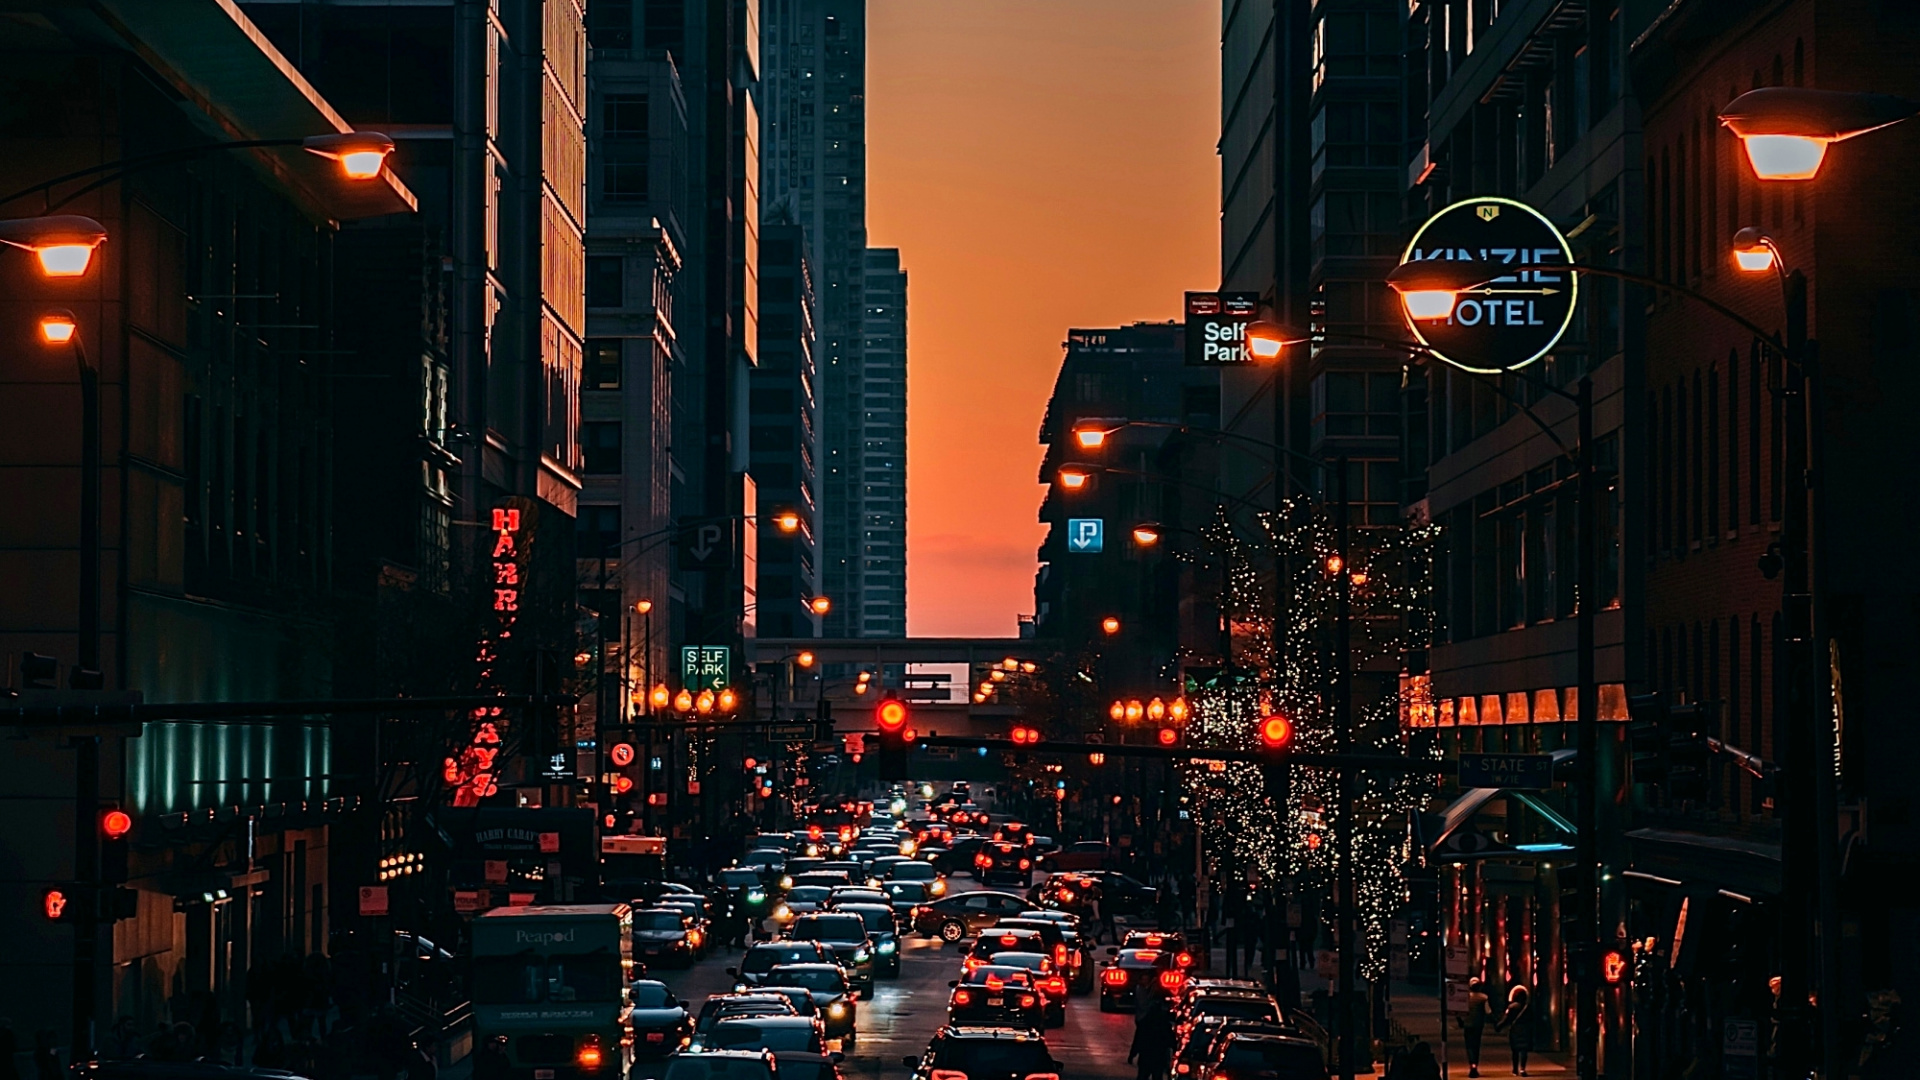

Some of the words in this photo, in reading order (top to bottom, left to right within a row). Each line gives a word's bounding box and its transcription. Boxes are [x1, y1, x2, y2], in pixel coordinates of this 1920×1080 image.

[1483, 208, 1493, 217] N
[1432, 300, 1544, 326] OTEL
[1204, 322, 1247, 341] Self
[1204, 343, 1252, 361] Park
[687, 651, 723, 662] SELF
[687, 664, 724, 675] PARK
[1463, 760, 1471, 769] N
[1481, 758, 1525, 772] STATE
[1536, 761, 1548, 771] ST
[475, 828, 503, 843] HARRY
[515, 928, 575, 946] Peapod
